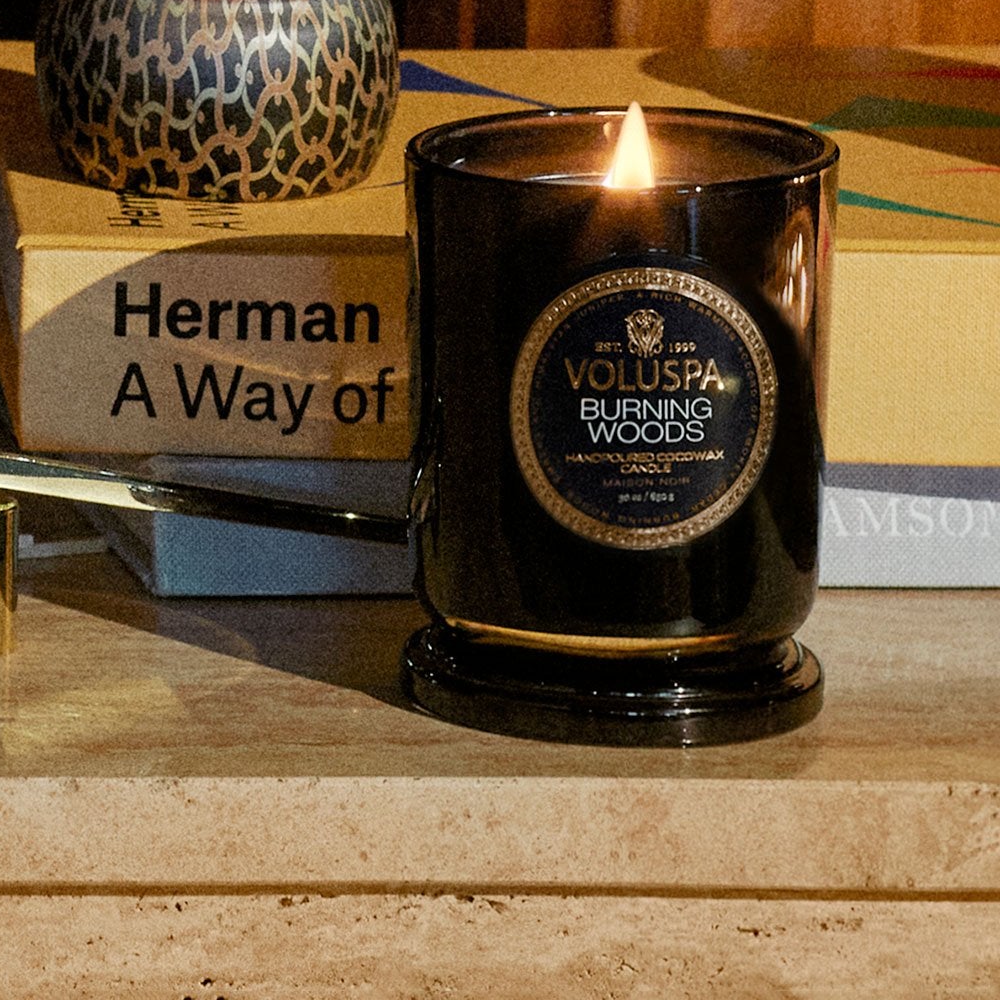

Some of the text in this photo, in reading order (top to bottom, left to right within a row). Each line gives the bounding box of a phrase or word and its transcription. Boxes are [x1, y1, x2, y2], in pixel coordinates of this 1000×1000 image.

[113, 281, 381, 344] Herman
[668, 341, 697, 353] 1999
[563, 358, 725, 392] VOLUSPA
[110, 362, 396, 436] A Way of
[580, 397, 712, 420] BURNING
[587, 420, 705, 444] WOODS
[620, 463, 672, 475] CANDLE
[603, 476, 691, 488] MAISON NOIR
